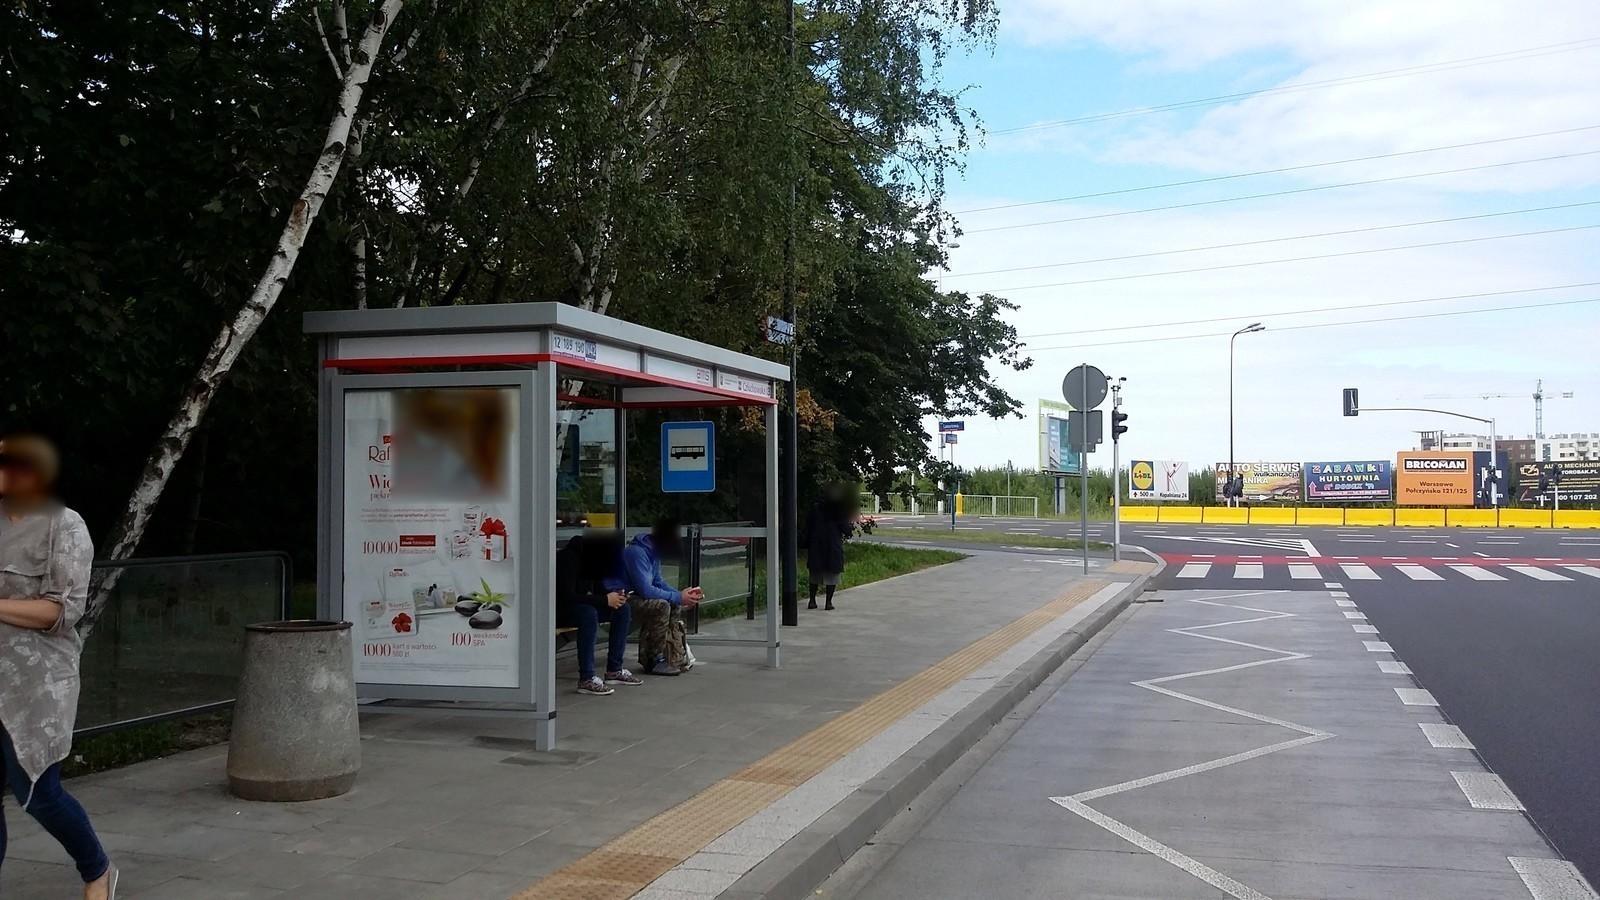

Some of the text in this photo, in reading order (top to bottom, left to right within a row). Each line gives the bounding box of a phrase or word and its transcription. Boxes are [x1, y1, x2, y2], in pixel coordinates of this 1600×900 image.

[554, 336, 561, 349] 12
[1253, 463, 1300, 472] SERWIS
[1312, 463, 1384, 474] ZABAWKI
[1405, 460, 1465, 469] BRICOMAN
[1319, 475, 1380, 483] HURTOWNIA
[451, 631, 472, 646] 100
[473, 639, 485, 647] SPA
[363, 643, 391, 657] 1000
